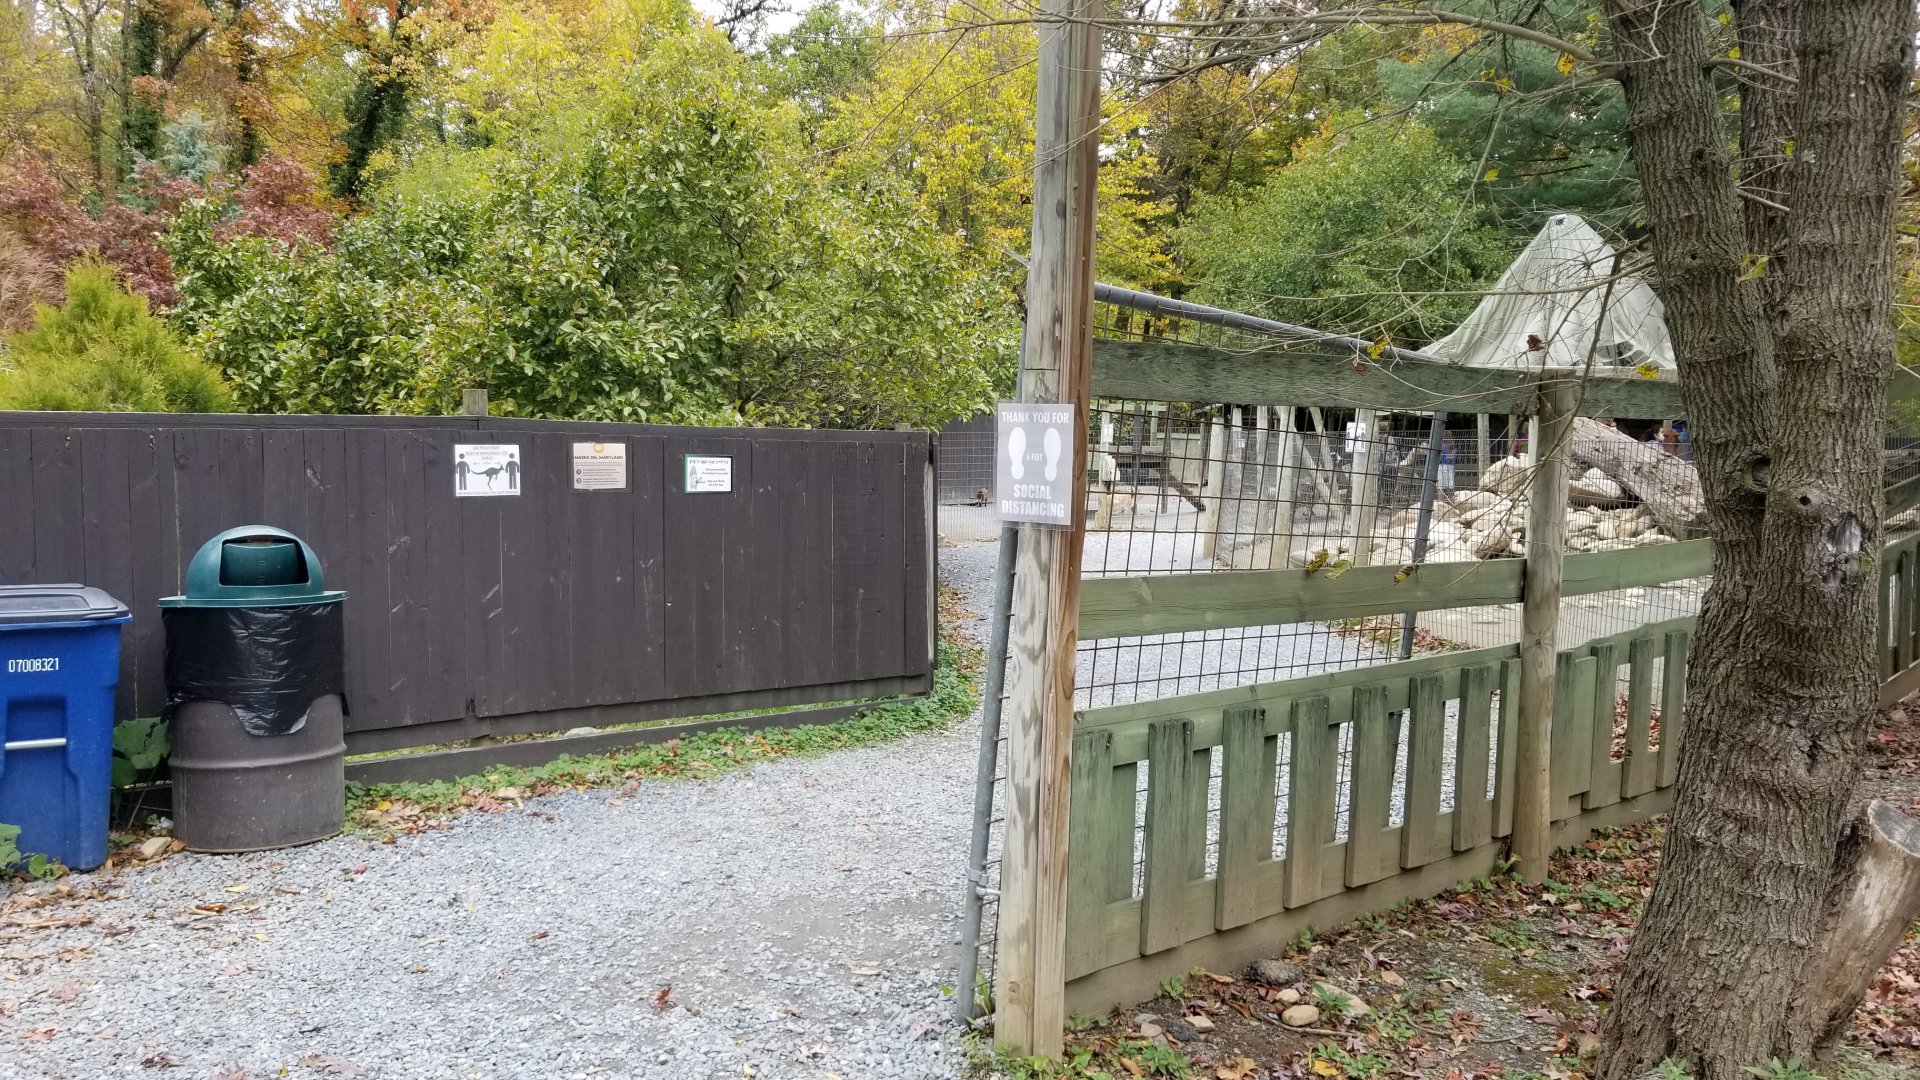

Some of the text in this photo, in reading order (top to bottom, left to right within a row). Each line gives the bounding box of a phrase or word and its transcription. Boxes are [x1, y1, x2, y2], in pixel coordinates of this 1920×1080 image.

[1002, 411, 1069, 424] THANK YOU FOR
[1031, 453, 1042, 461] FEET
[1013, 484, 1052, 499] SOCIAL
[1001, 500, 1065, 518] DISTANCING
[8, 657, 59, 673] 07008321
